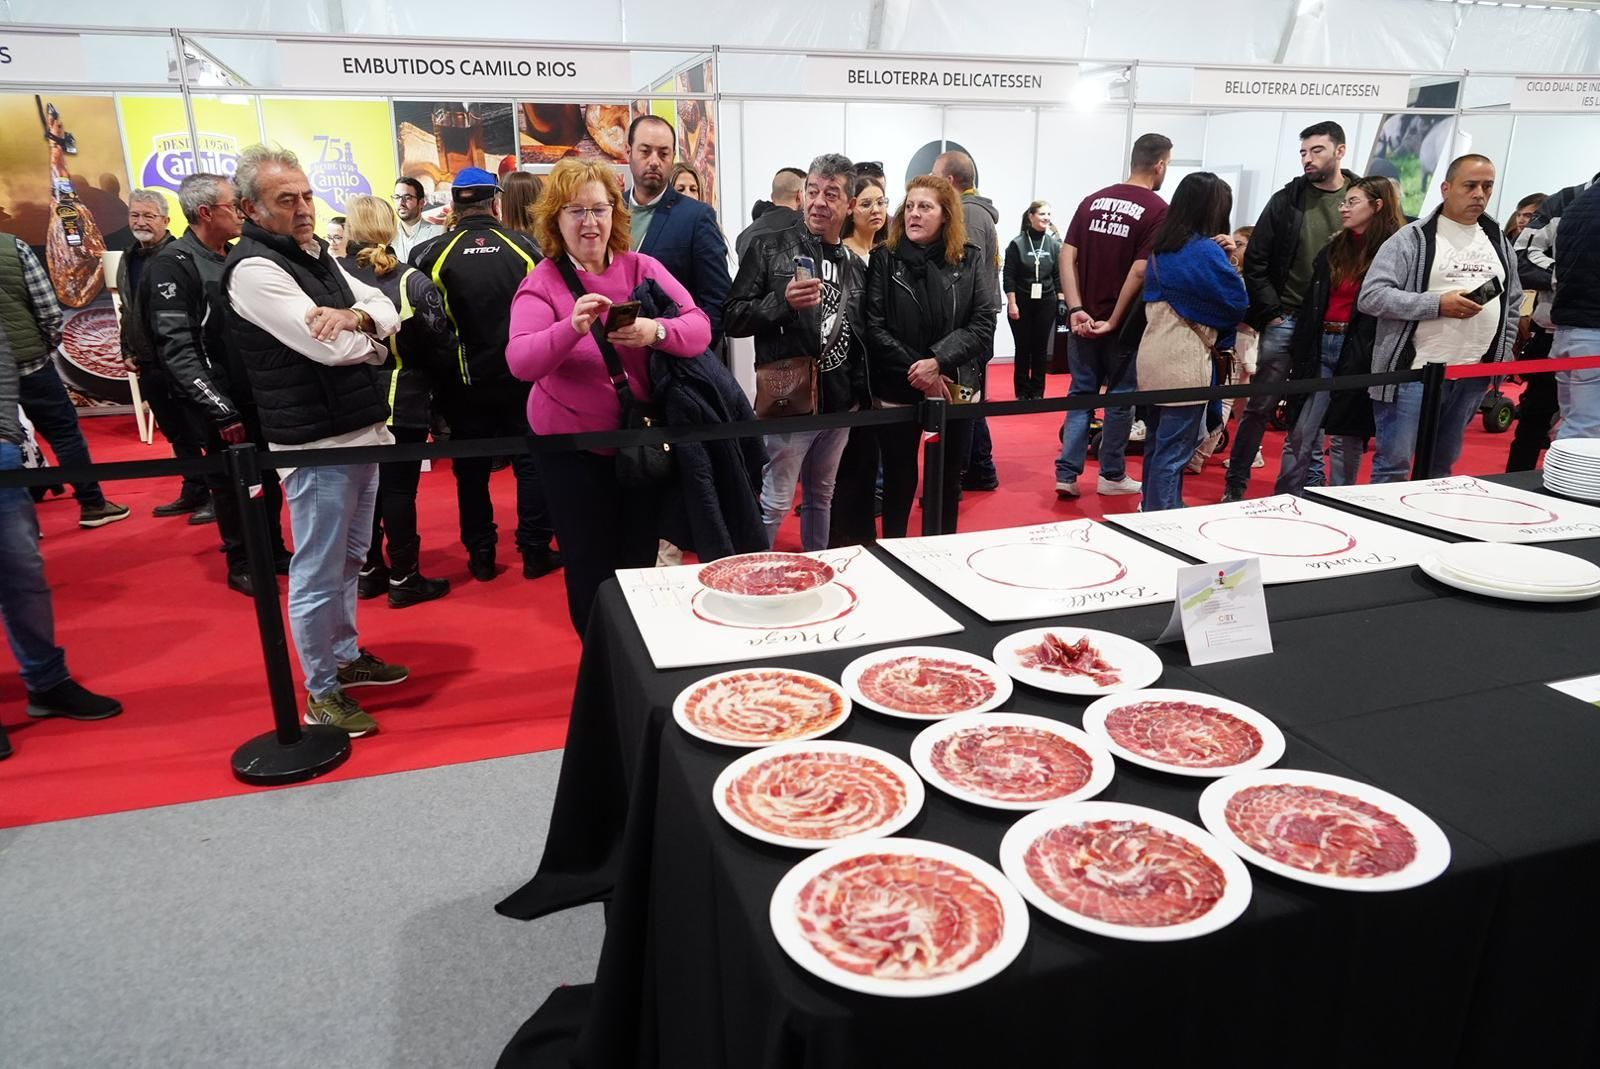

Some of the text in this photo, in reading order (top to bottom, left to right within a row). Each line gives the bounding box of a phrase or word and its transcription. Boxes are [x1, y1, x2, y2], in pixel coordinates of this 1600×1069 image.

[342, 57, 577, 77] EMBUTIDOS CAMILO RIOS
[848, 69, 1042, 88] BELLOTERRA DELICATESSEN
[1527, 81, 1551, 92] CICLO
[1552, 81, 1575, 92] DUAL
[1576, 82, 1588, 92] DE
[1225, 80, 1380, 97] BELLOTERRA DELICATESSEN
[1581, 96, 1594, 106] IES
[313, 135, 344, 163] 75
[310, 169, 360, 192] Camilo
[1090, 197, 1146, 221] CONVERSE
[1089, 219, 1130, 238] ALL STAR
[1305, 552, 1397, 569] Punta
